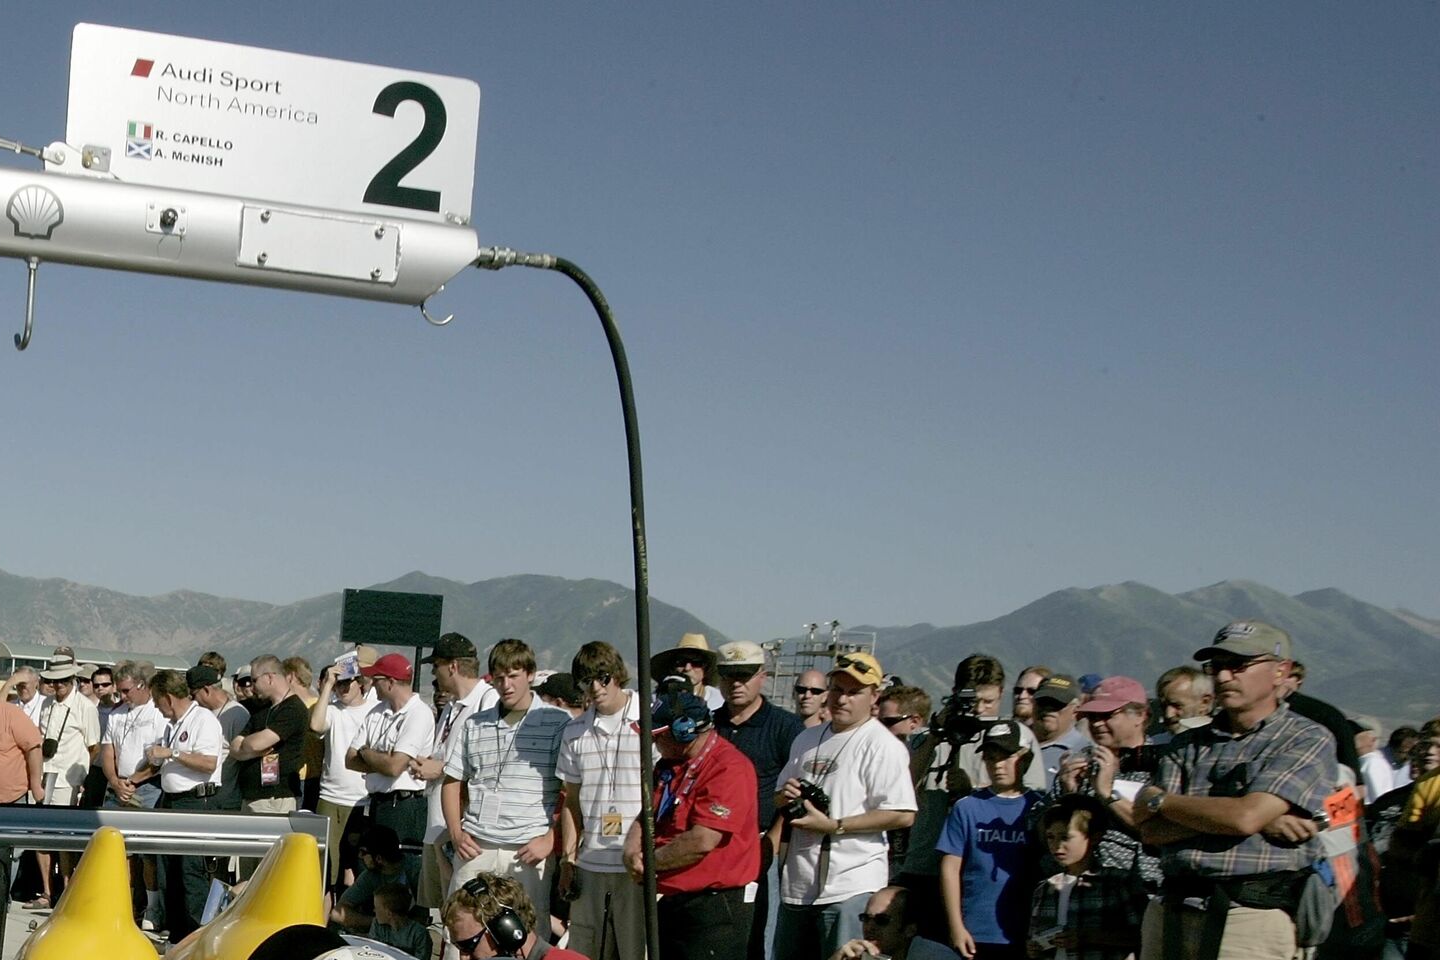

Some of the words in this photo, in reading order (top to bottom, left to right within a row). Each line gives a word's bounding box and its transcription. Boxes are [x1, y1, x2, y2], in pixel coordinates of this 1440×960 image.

[160, 62, 213, 84] Audi
[220, 70, 282, 95] Sport
[157, 85, 220, 110] North
[226, 96, 319, 125] America
[155, 129, 168, 141] R.
[172, 132, 234, 151] CAPELLO
[363, 80, 447, 212] 2
[154, 147, 167, 159] A.
[171, 150, 224, 168] McNISH
[977, 828, 1027, 845] ITALIA
